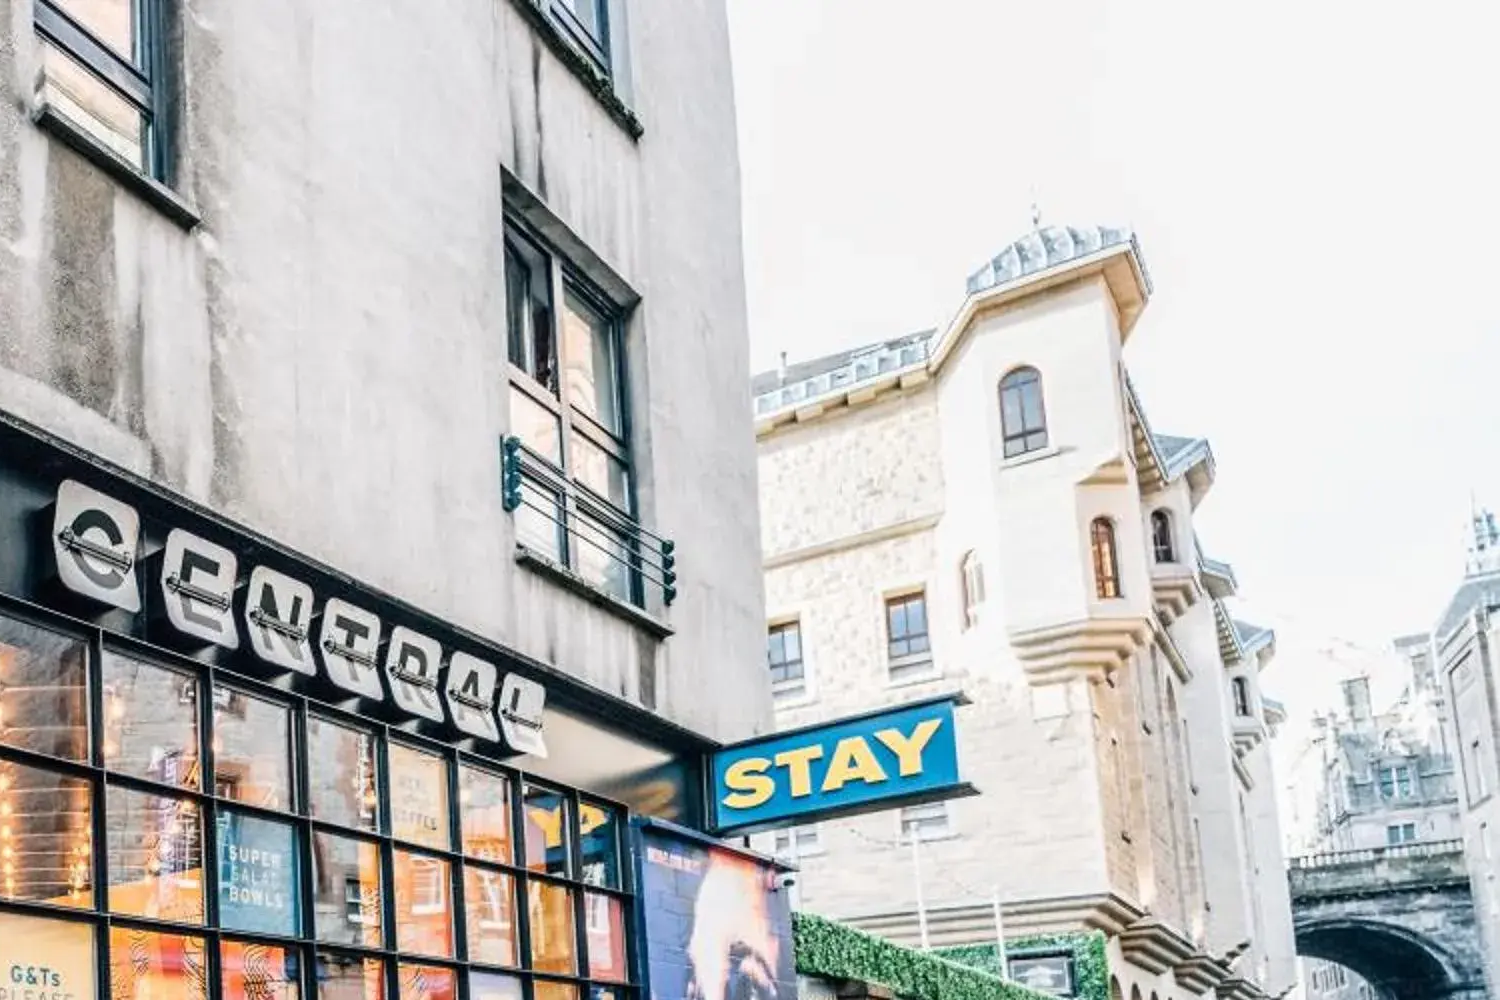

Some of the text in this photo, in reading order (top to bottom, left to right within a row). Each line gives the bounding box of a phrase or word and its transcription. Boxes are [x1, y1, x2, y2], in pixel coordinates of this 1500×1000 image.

[66, 507, 543, 744] CENTRAL
[721, 718, 943, 810] STAY
[229, 844, 282, 868] SUPER
[229, 885, 284, 909] BOWLS
[10, 965, 61, 987] G&Ts
